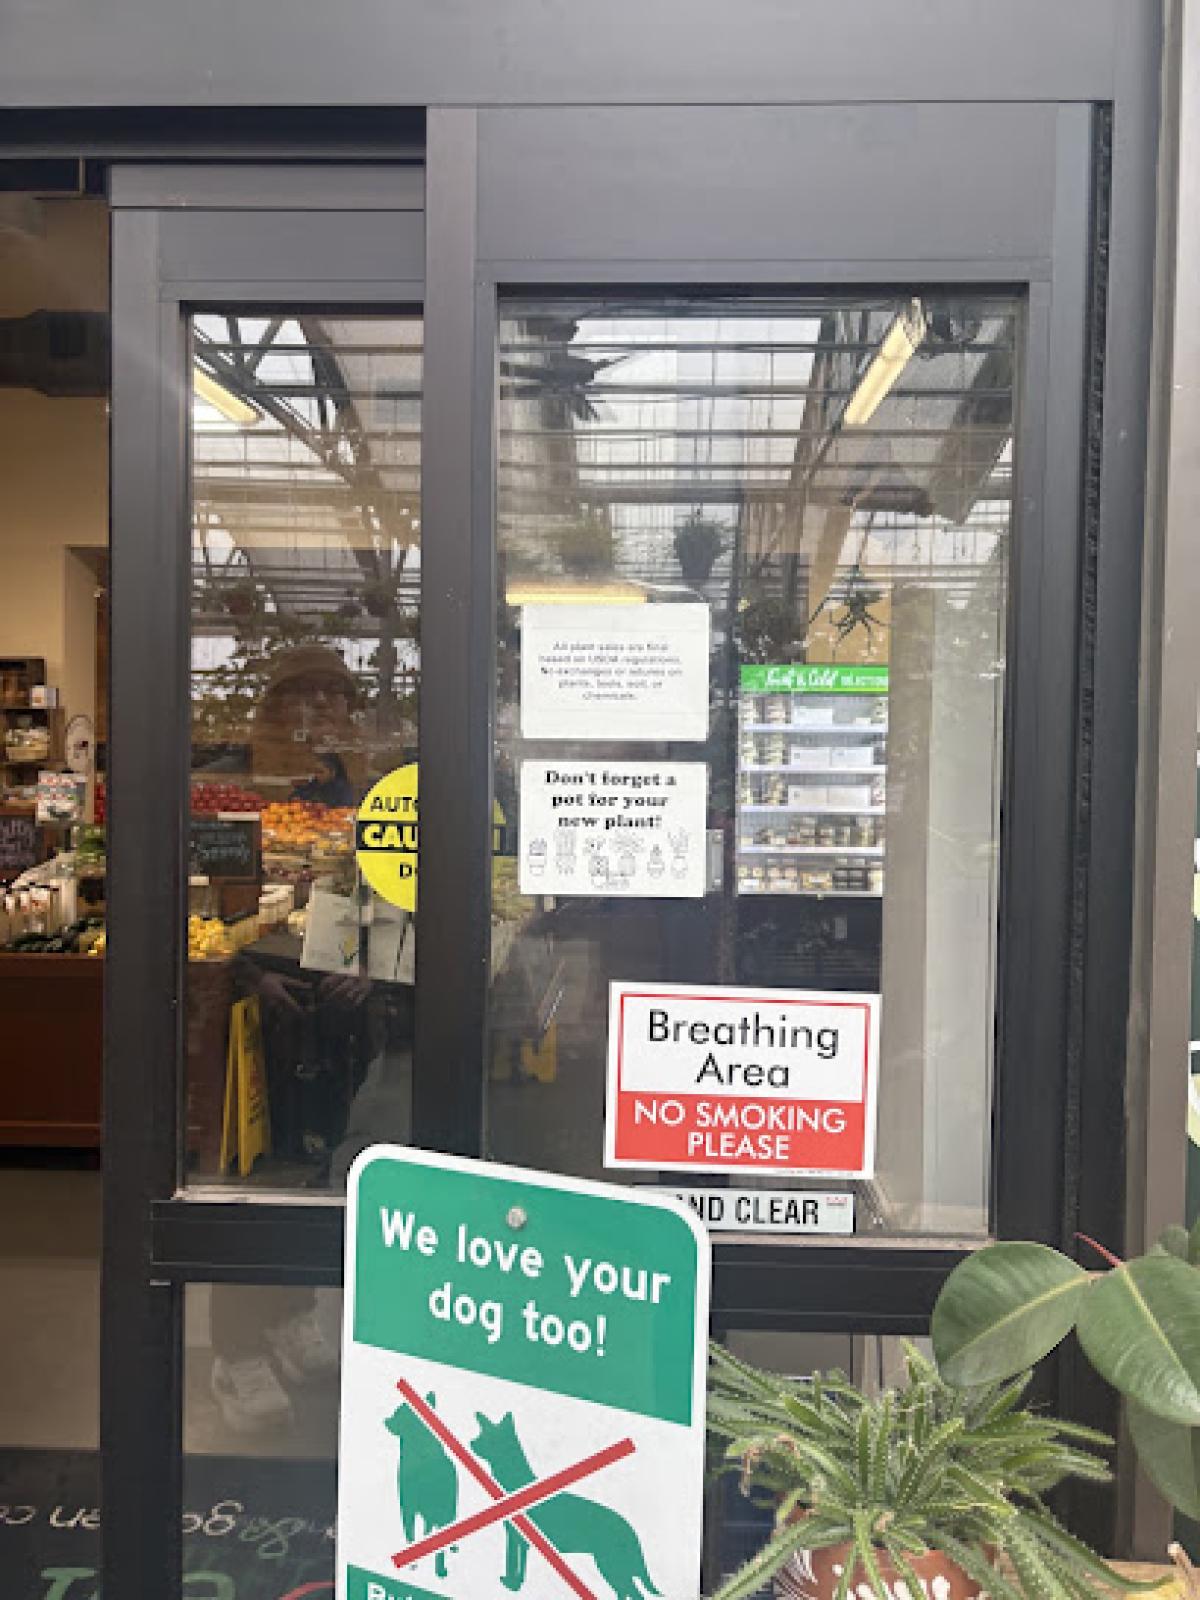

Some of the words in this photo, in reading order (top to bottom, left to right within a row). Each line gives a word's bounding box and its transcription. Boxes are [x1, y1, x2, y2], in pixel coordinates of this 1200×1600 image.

[570, 642, 594, 653] plant
[545, 770, 597, 785] Don't
[602, 770, 660, 788] forget
[665, 775, 677, 786] a
[552, 793, 582, 809] pot
[588, 792, 618, 806] for
[623, 796, 668, 809] your
[559, 816, 598, 827] new
[605, 814, 662, 830] plant!
[648, 1008, 840, 1060] Breathing
[694, 1052, 790, 1089] Area
[634, 1099, 687, 1127] NO
[696, 1102, 847, 1134] SMOKING
[688, 1131, 790, 1160] PLEASE
[676, 1194, 724, 1221] ND
[735, 1197, 819, 1225] CLEAR
[380, 1207, 439, 1257] We
[457, 1224, 545, 1279] love
[564, 1254, 672, 1304] your
[428, 1281, 503, 1344] dog
[522, 1300, 608, 1358] too!
